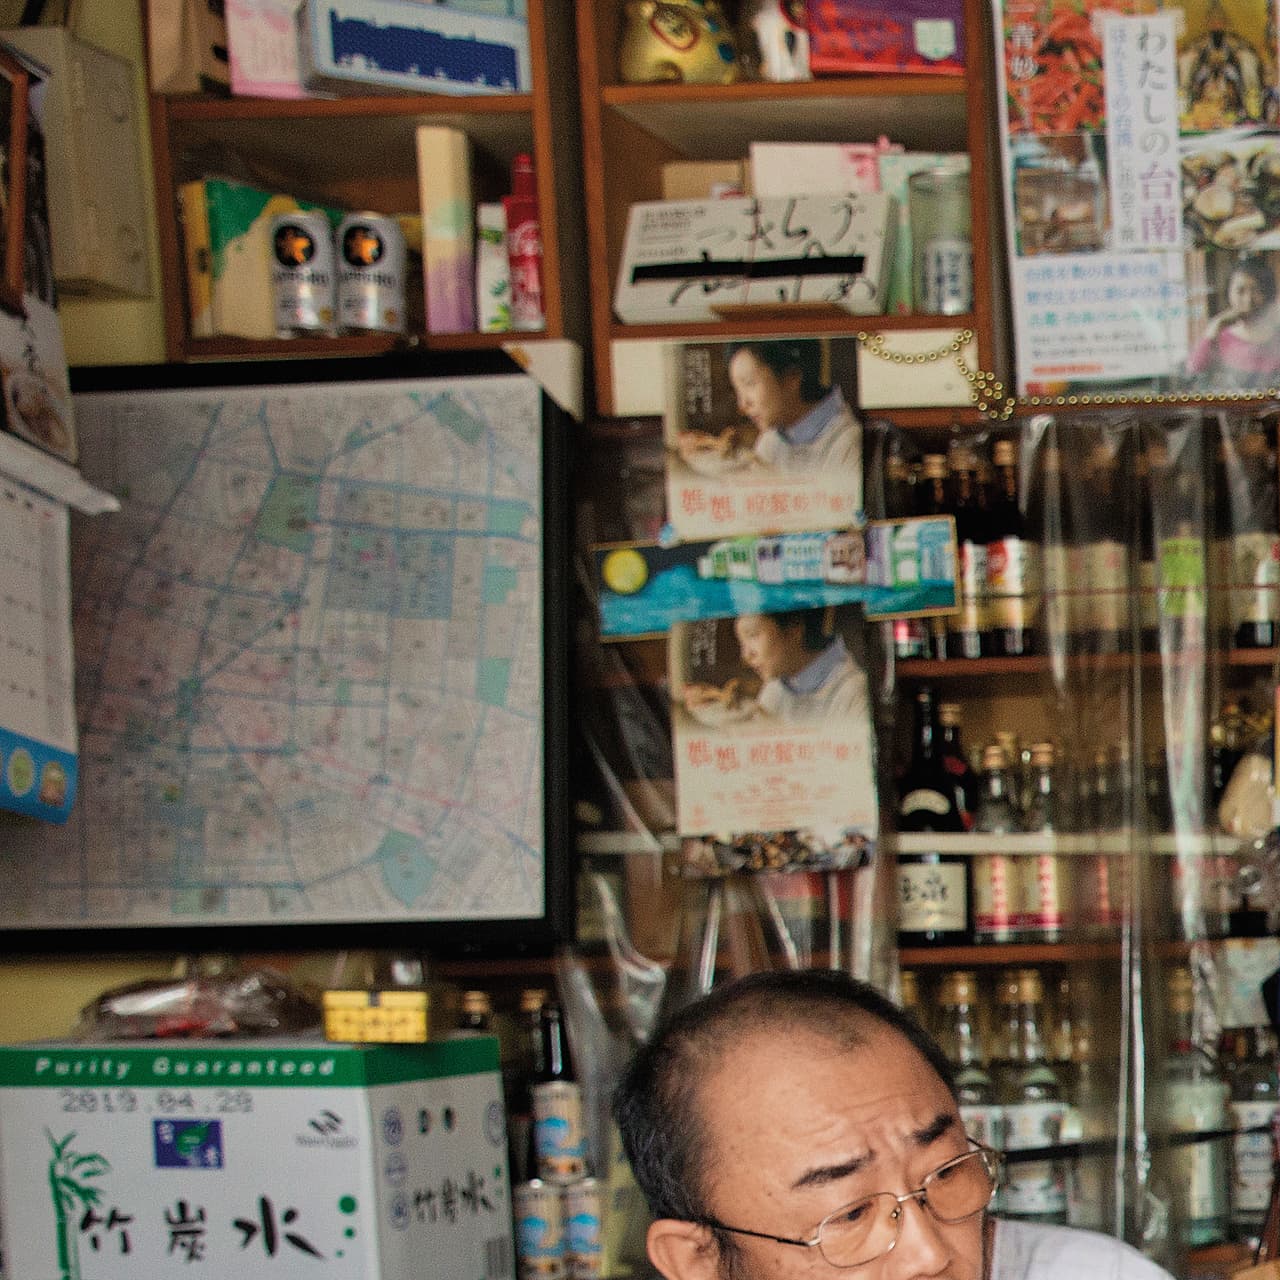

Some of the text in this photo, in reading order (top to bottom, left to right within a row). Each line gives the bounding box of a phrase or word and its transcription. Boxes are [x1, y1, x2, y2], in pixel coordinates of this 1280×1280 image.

[1137, 26, 1178, 243] わたしの台南
[35, 1057, 336, 1079] Purity Guaranteed
[80, 1193, 332, 1263] 竹炭水
